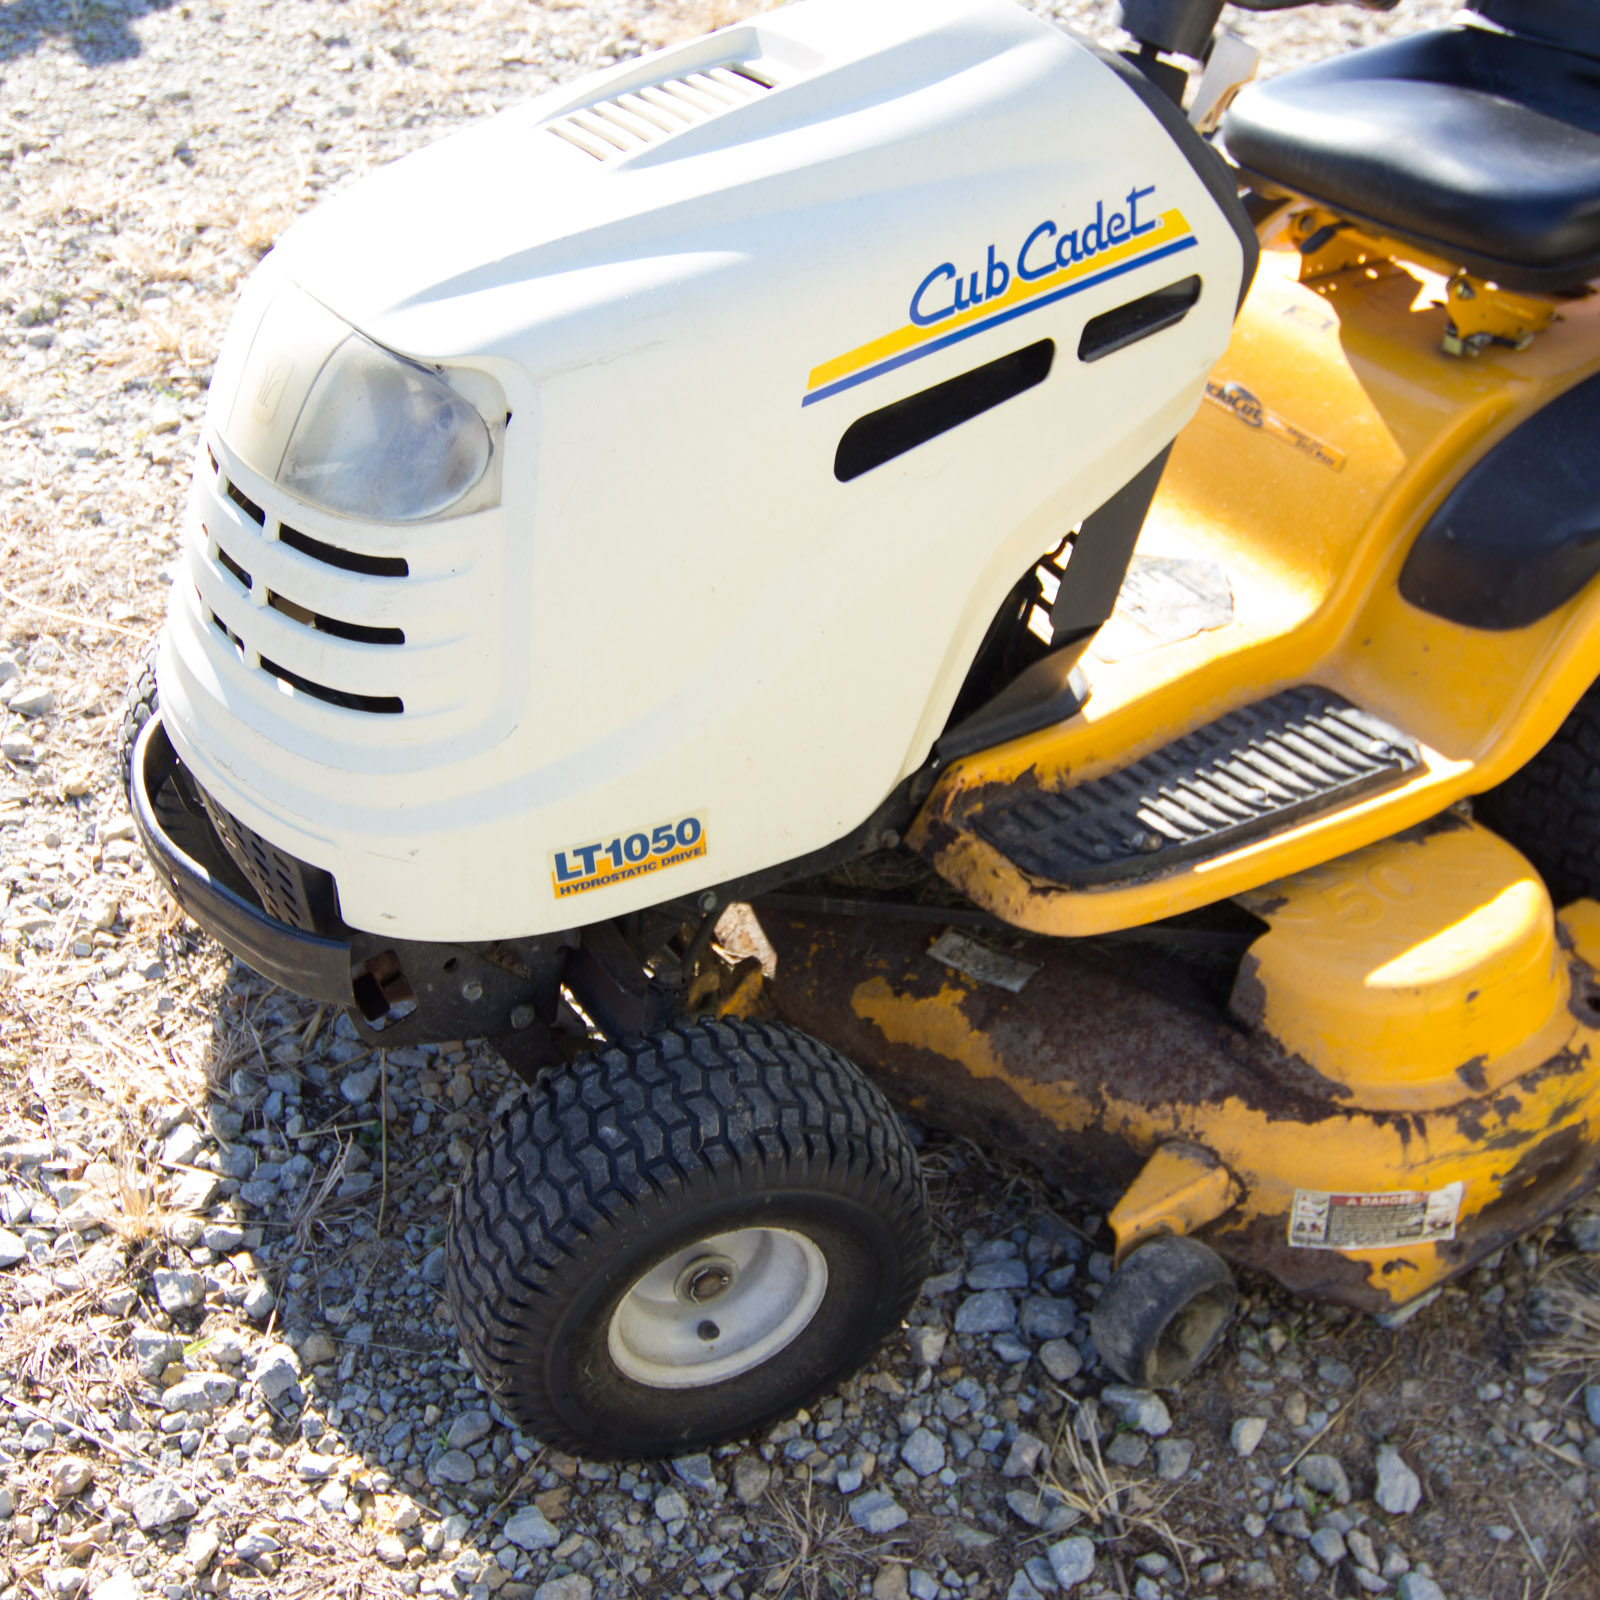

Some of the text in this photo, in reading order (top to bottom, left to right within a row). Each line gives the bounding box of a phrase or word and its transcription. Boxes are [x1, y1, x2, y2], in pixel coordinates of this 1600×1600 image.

[909, 185, 1155, 326] Cub Cadet
[554, 817, 701, 882] LT1050
[559, 846, 702, 896] HYDROSTATIC DRIVE
